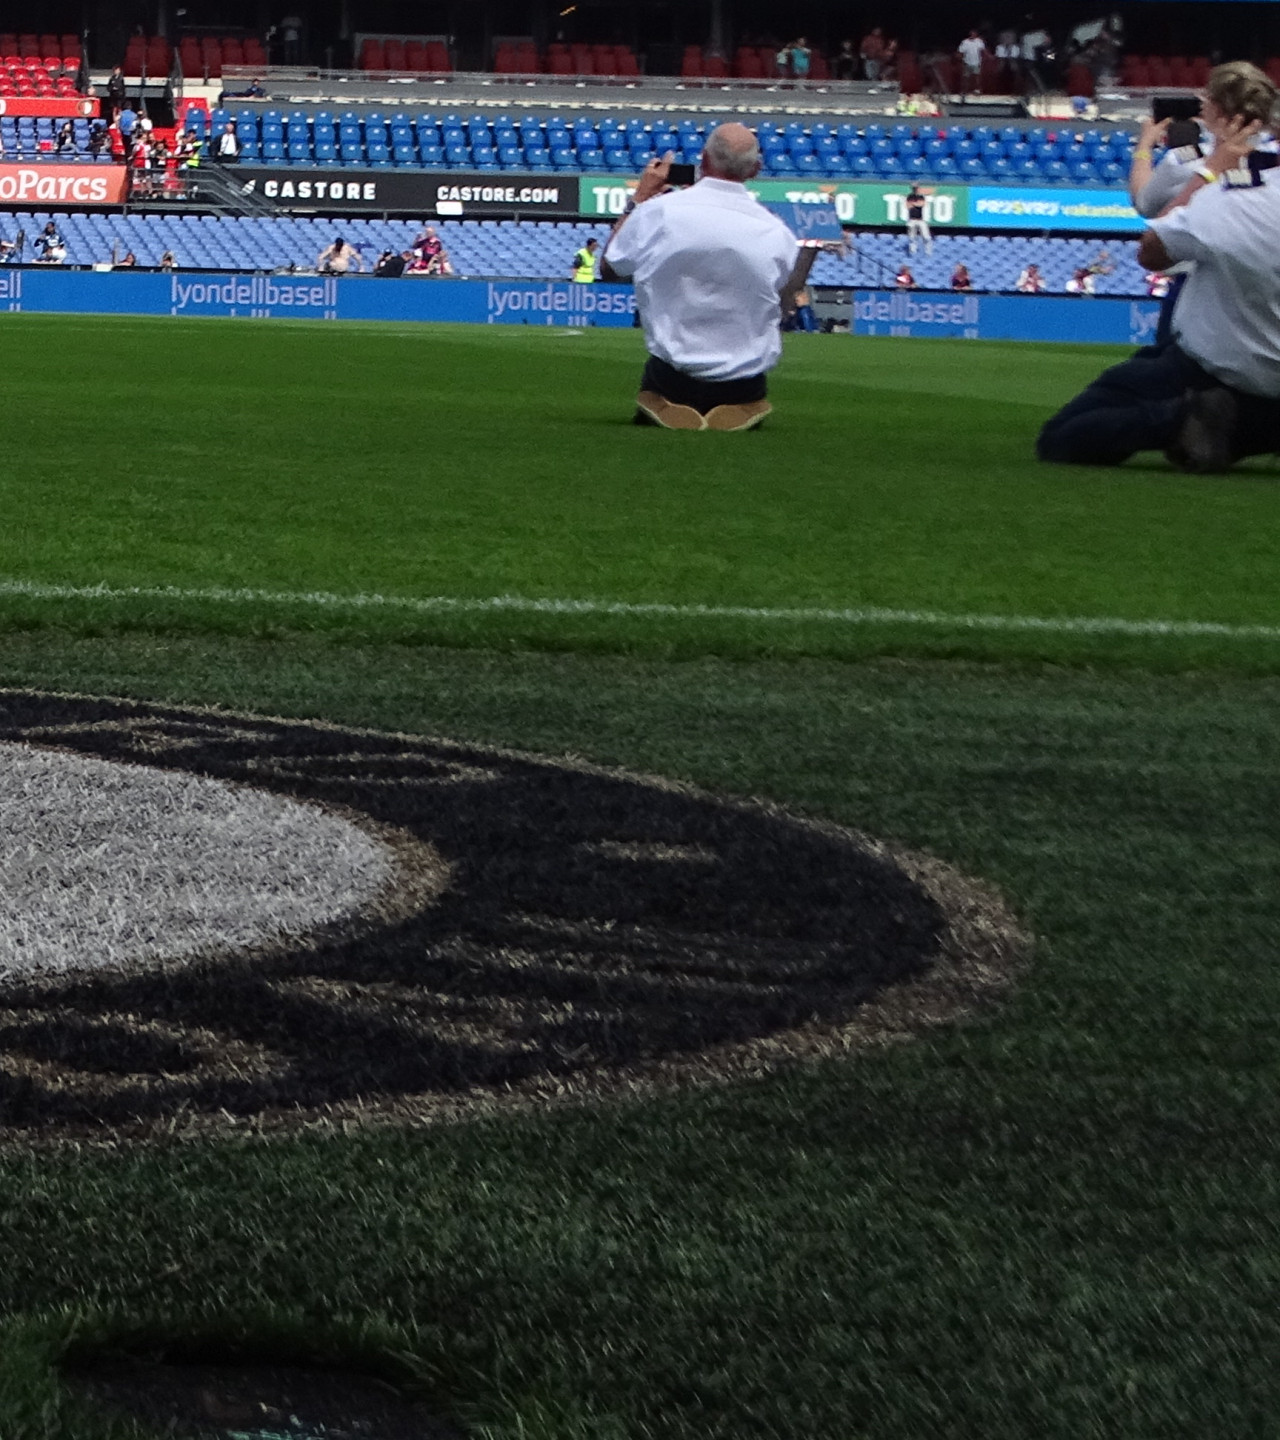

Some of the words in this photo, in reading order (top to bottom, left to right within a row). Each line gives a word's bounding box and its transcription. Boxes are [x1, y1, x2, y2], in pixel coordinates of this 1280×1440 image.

[264, 180, 376, 200] CASTORE
[437, 186, 558, 204] CASTORE.COM
[171, 274, 336, 308] lyondellbasell
[488, 282, 636, 315] lyondellbase
